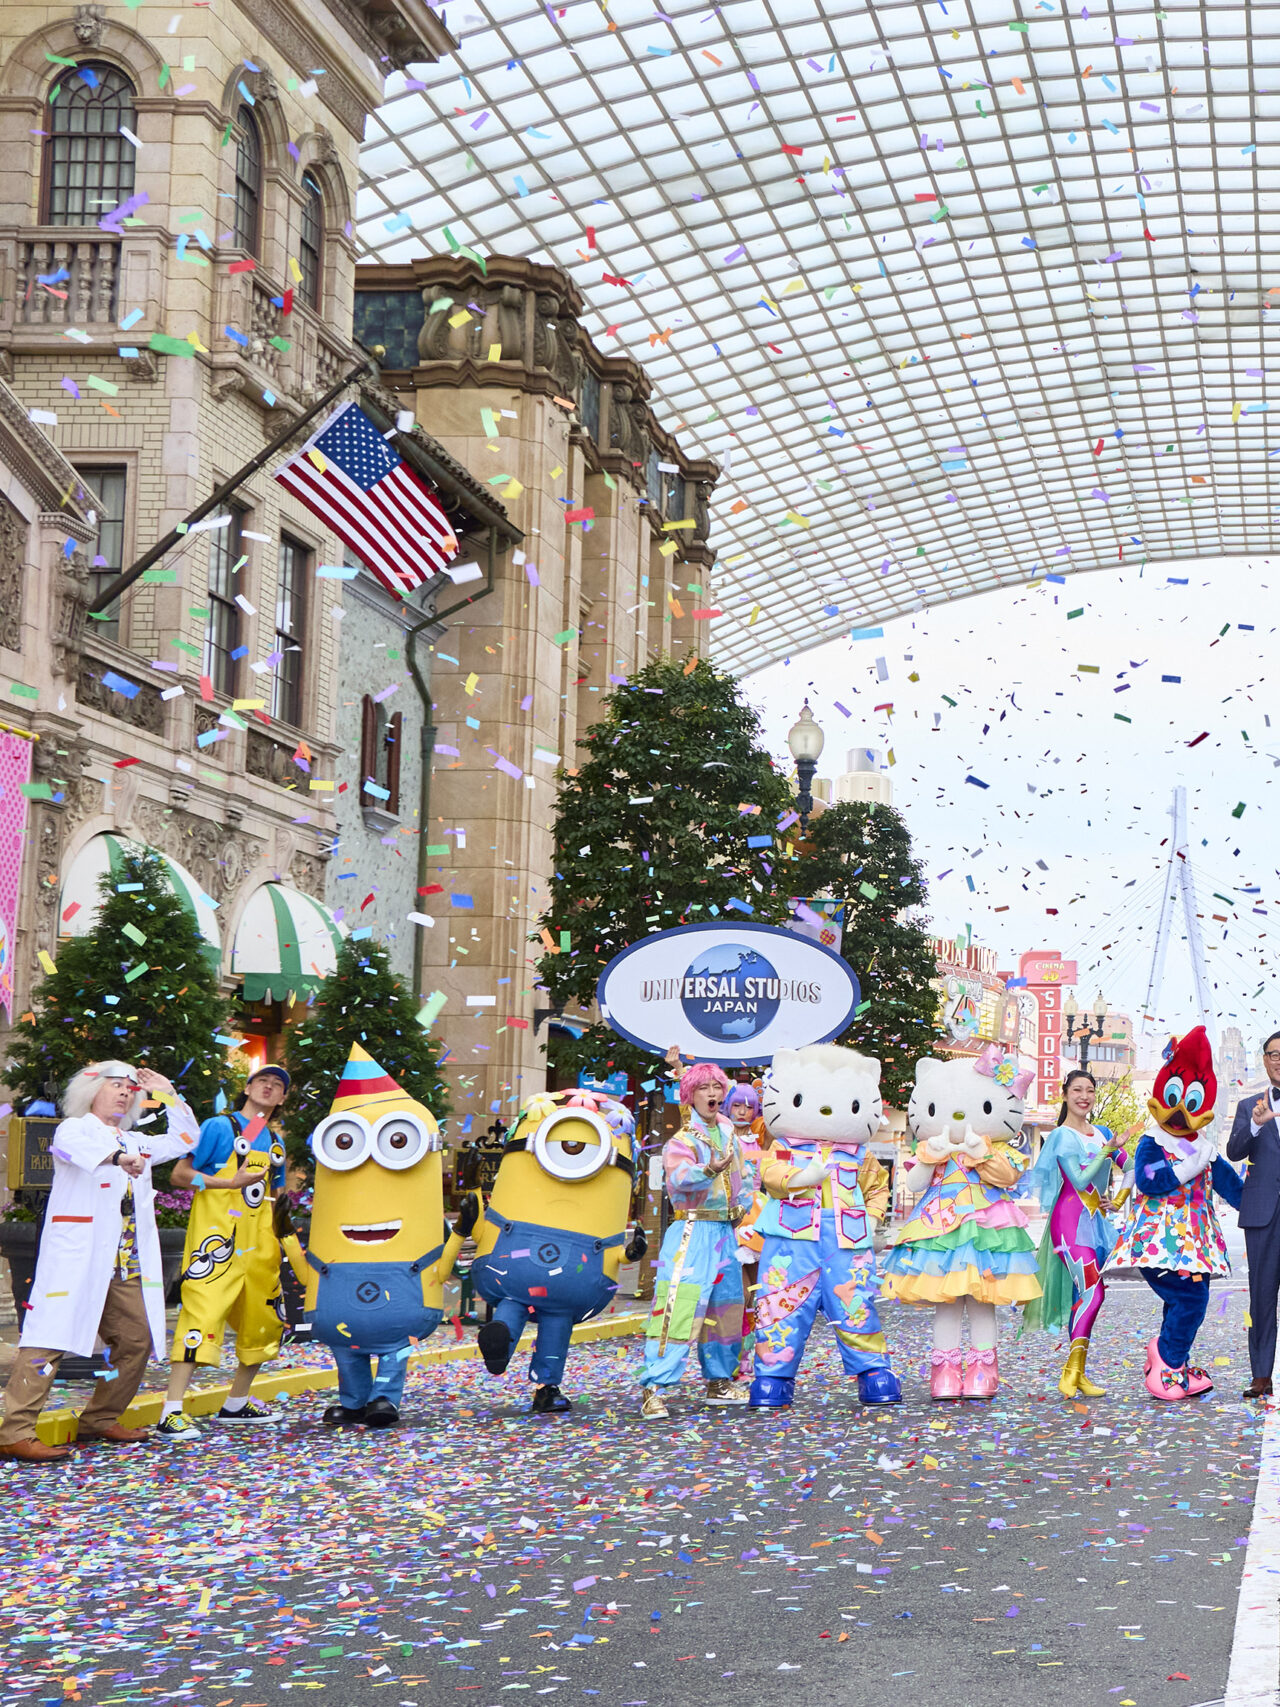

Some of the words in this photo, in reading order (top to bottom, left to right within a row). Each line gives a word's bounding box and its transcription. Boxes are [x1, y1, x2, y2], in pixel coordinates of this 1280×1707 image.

[1035, 962, 1064, 970] CINEMA
[640, 977, 739, 1002] UNIVERSAL
[745, 977, 822, 1004] STUDIOS
[703, 1000, 758, 1014] JAPAN
[1043, 990, 1055, 1102] STORE
